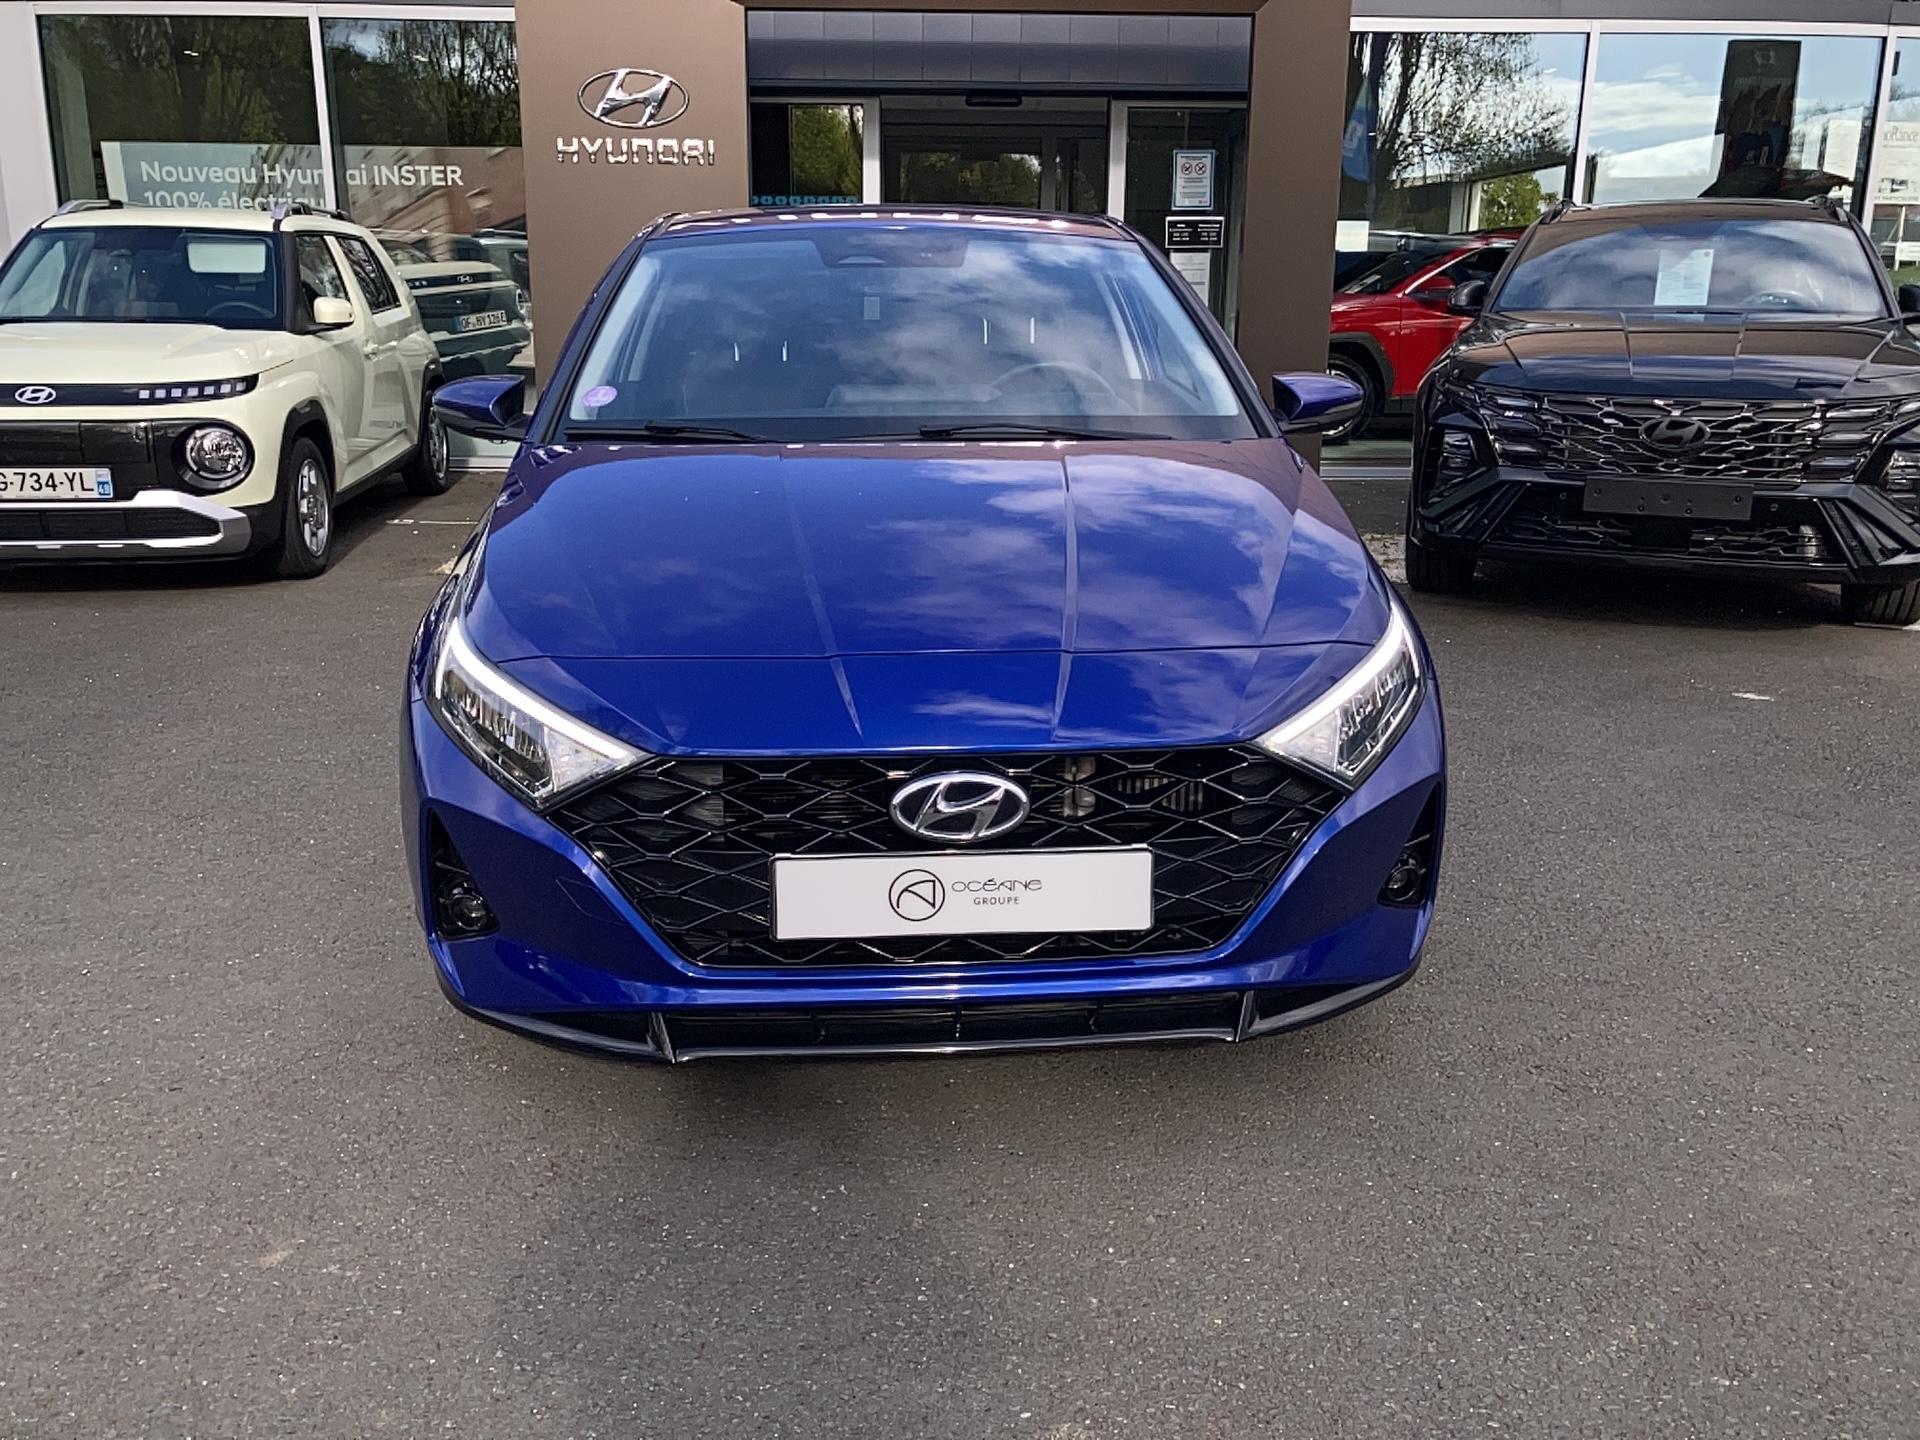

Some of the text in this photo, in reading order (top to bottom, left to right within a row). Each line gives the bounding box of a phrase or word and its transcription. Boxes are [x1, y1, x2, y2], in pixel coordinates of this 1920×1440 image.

[556, 137, 715, 165] HYUNDAI
[140, 160, 257, 184] Nouveau
[373, 165, 464, 187] INSTER
[143, 190, 212, 209] 100%
[951, 877, 1043, 893] OCÉANE
[973, 896, 1021, 906] GROUPE
